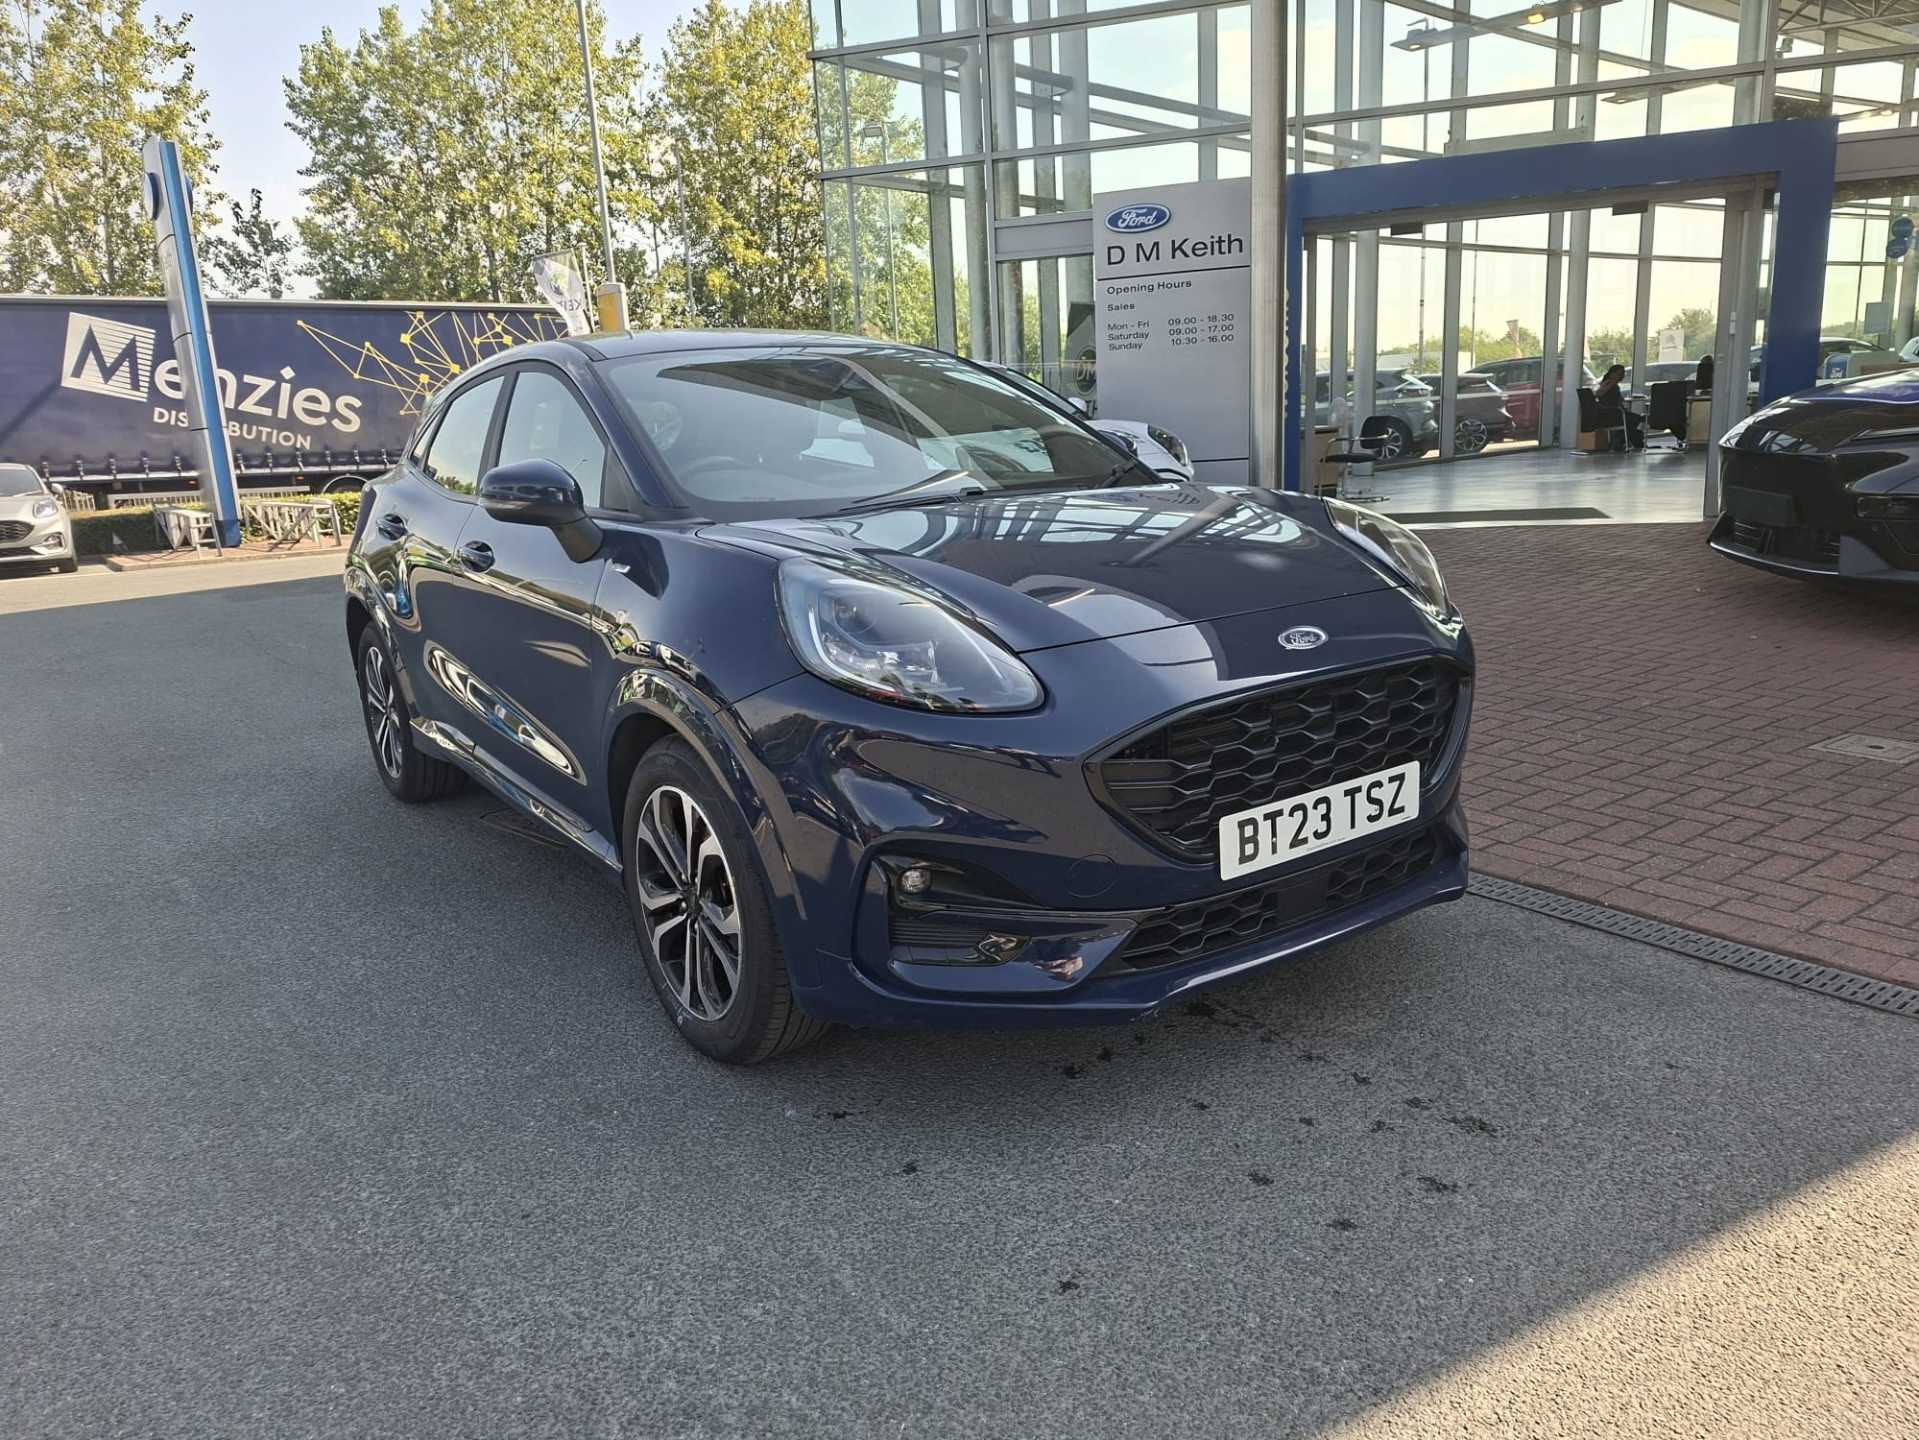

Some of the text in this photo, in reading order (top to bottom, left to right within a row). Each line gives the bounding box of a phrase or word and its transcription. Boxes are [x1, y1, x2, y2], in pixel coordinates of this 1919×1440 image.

[1118, 208, 1157, 228] Ford
[1107, 233, 1243, 266] D M Keith
[1107, 281, 1192, 295] Opening Hours
[1107, 303, 1135, 312] Sales
[1108, 322, 1128, 331] Mon
[1138, 320, 1150, 329] Fri
[1168, 317, 1197, 326] 09.00
[1208, 313, 1234, 323] 18.30
[1108, 331, 1150, 341] Saturday
[1168, 327, 1197, 336] 09.00
[1208, 324, 1234, 333] 17.00
[1108, 341, 1143, 351] Sunday
[1171, 337, 1198, 346] 10.30
[1208, 334, 1234, 343] 16.00
[153, 407, 311, 450] DISBUTION
[1237, 772, 1406, 866] BT23 TSZ
